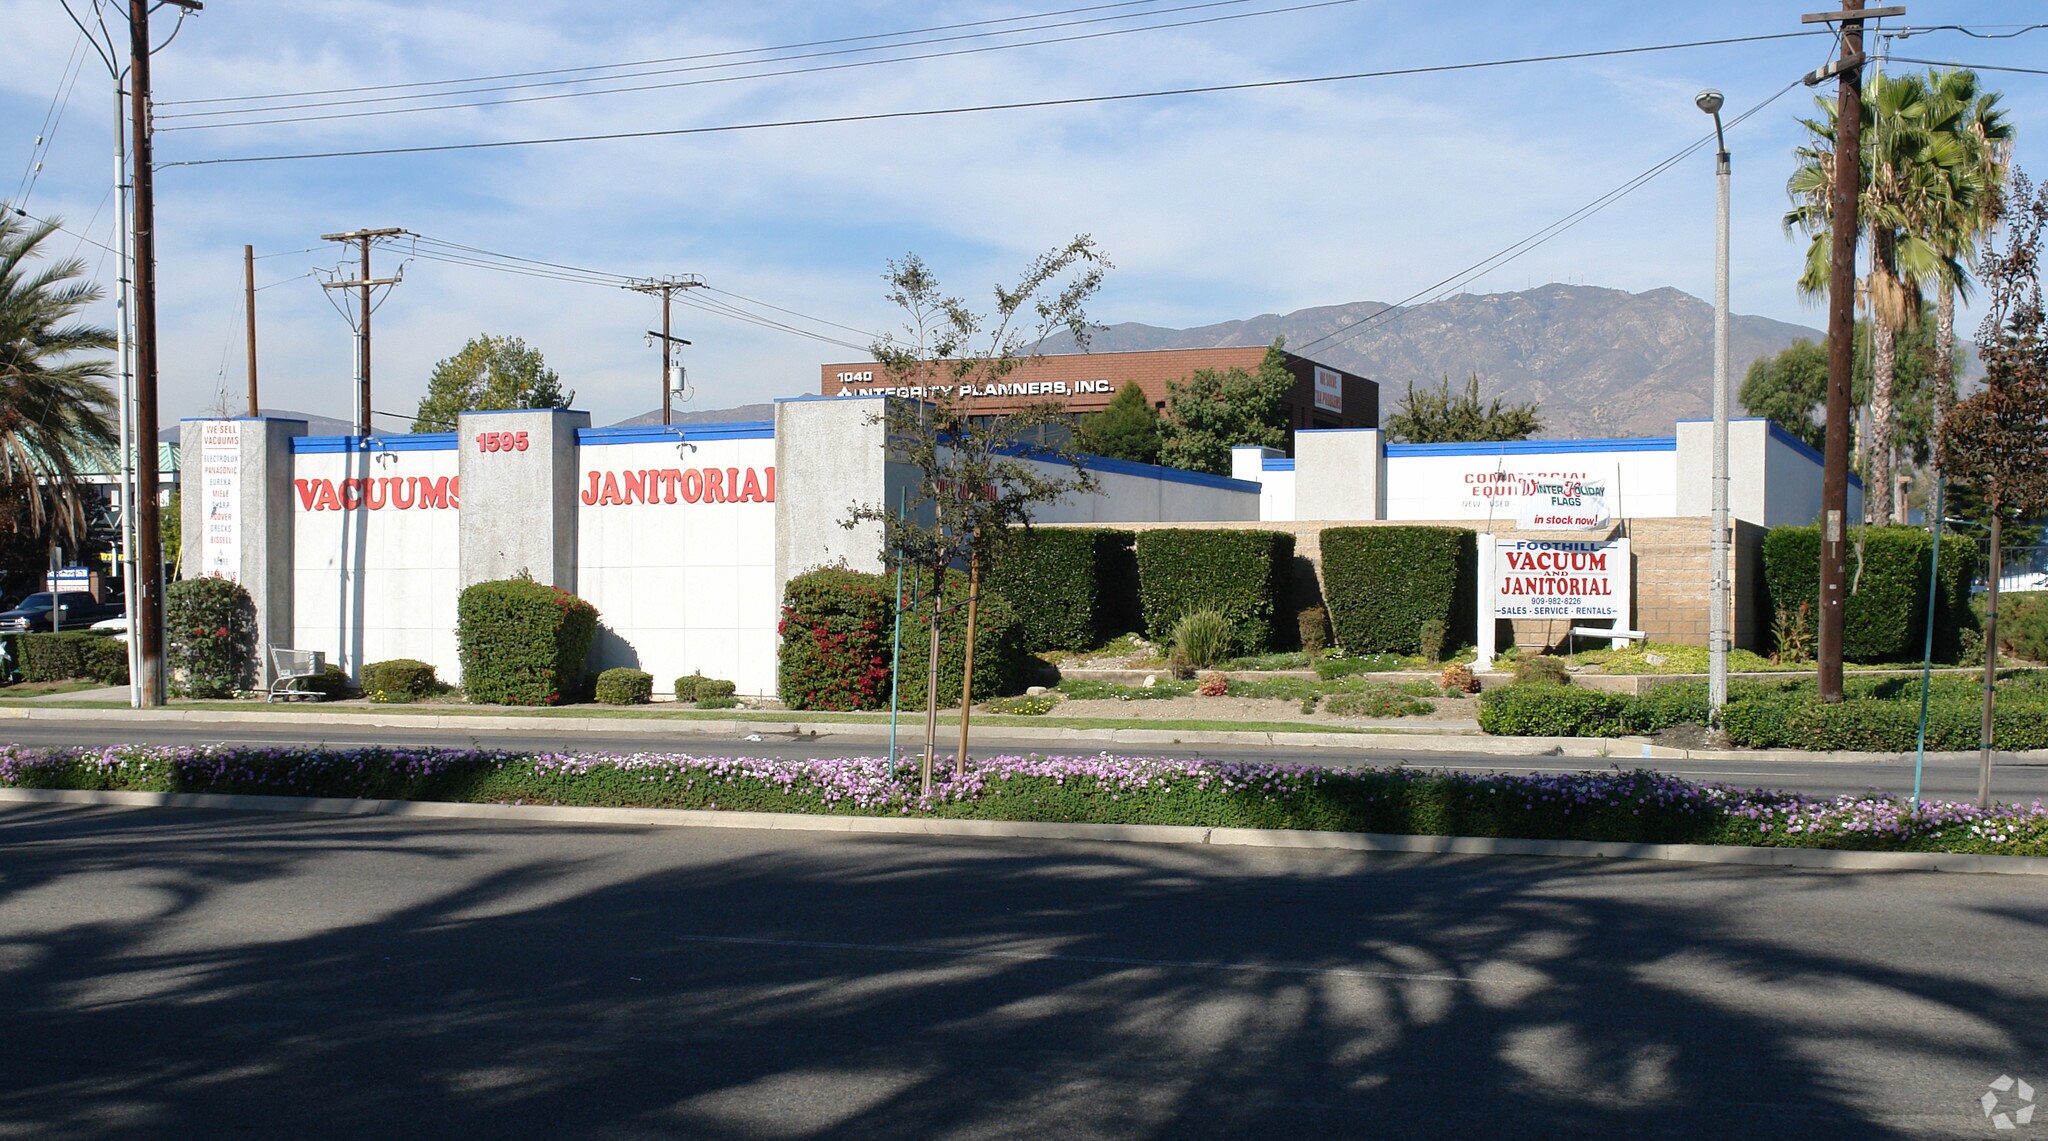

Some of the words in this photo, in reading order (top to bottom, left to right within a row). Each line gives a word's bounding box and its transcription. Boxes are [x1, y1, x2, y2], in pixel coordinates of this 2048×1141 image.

[837, 371, 873, 383] 1040
[959, 380, 1071, 396] PLANNERS,
[1075, 379, 1115, 393] INC.
[206, 425, 218, 434] WE
[219, 425, 237, 434] SELL
[204, 436, 240, 445] VACUUMS
[476, 431, 529, 452] 1595
[204, 455, 239, 463] ELECTROLUX
[204, 466, 238, 475] PANASONIC
[210, 478, 231, 486] EUREKA
[1518, 479, 1563, 497] WINTER
[1563, 481, 1605, 498] HOLIDAY
[212, 490, 230, 498] MIELE
[1462, 500, 1481, 508] NEW
[1489, 500, 1510, 508] USED
[1551, 496, 1582, 507] FLAGS
[1534, 514, 1544, 525] in
[1546, 515, 1573, 525] stock
[1575, 514, 1599, 527] now!
[210, 536, 232, 545] BISSELL
[1516, 541, 1600, 552] FOOTHILL
[1505, 551, 1607, 571] VACUUM
[1501, 577, 1612, 596] JANITORIAL
[1531, 597, 1581, 605] 909-982-8226
[1501, 607, 1527, 615] SALES
[1534, 607, 1569, 615] SERVICE
[1576, 607, 1612, 615] RENTALS
